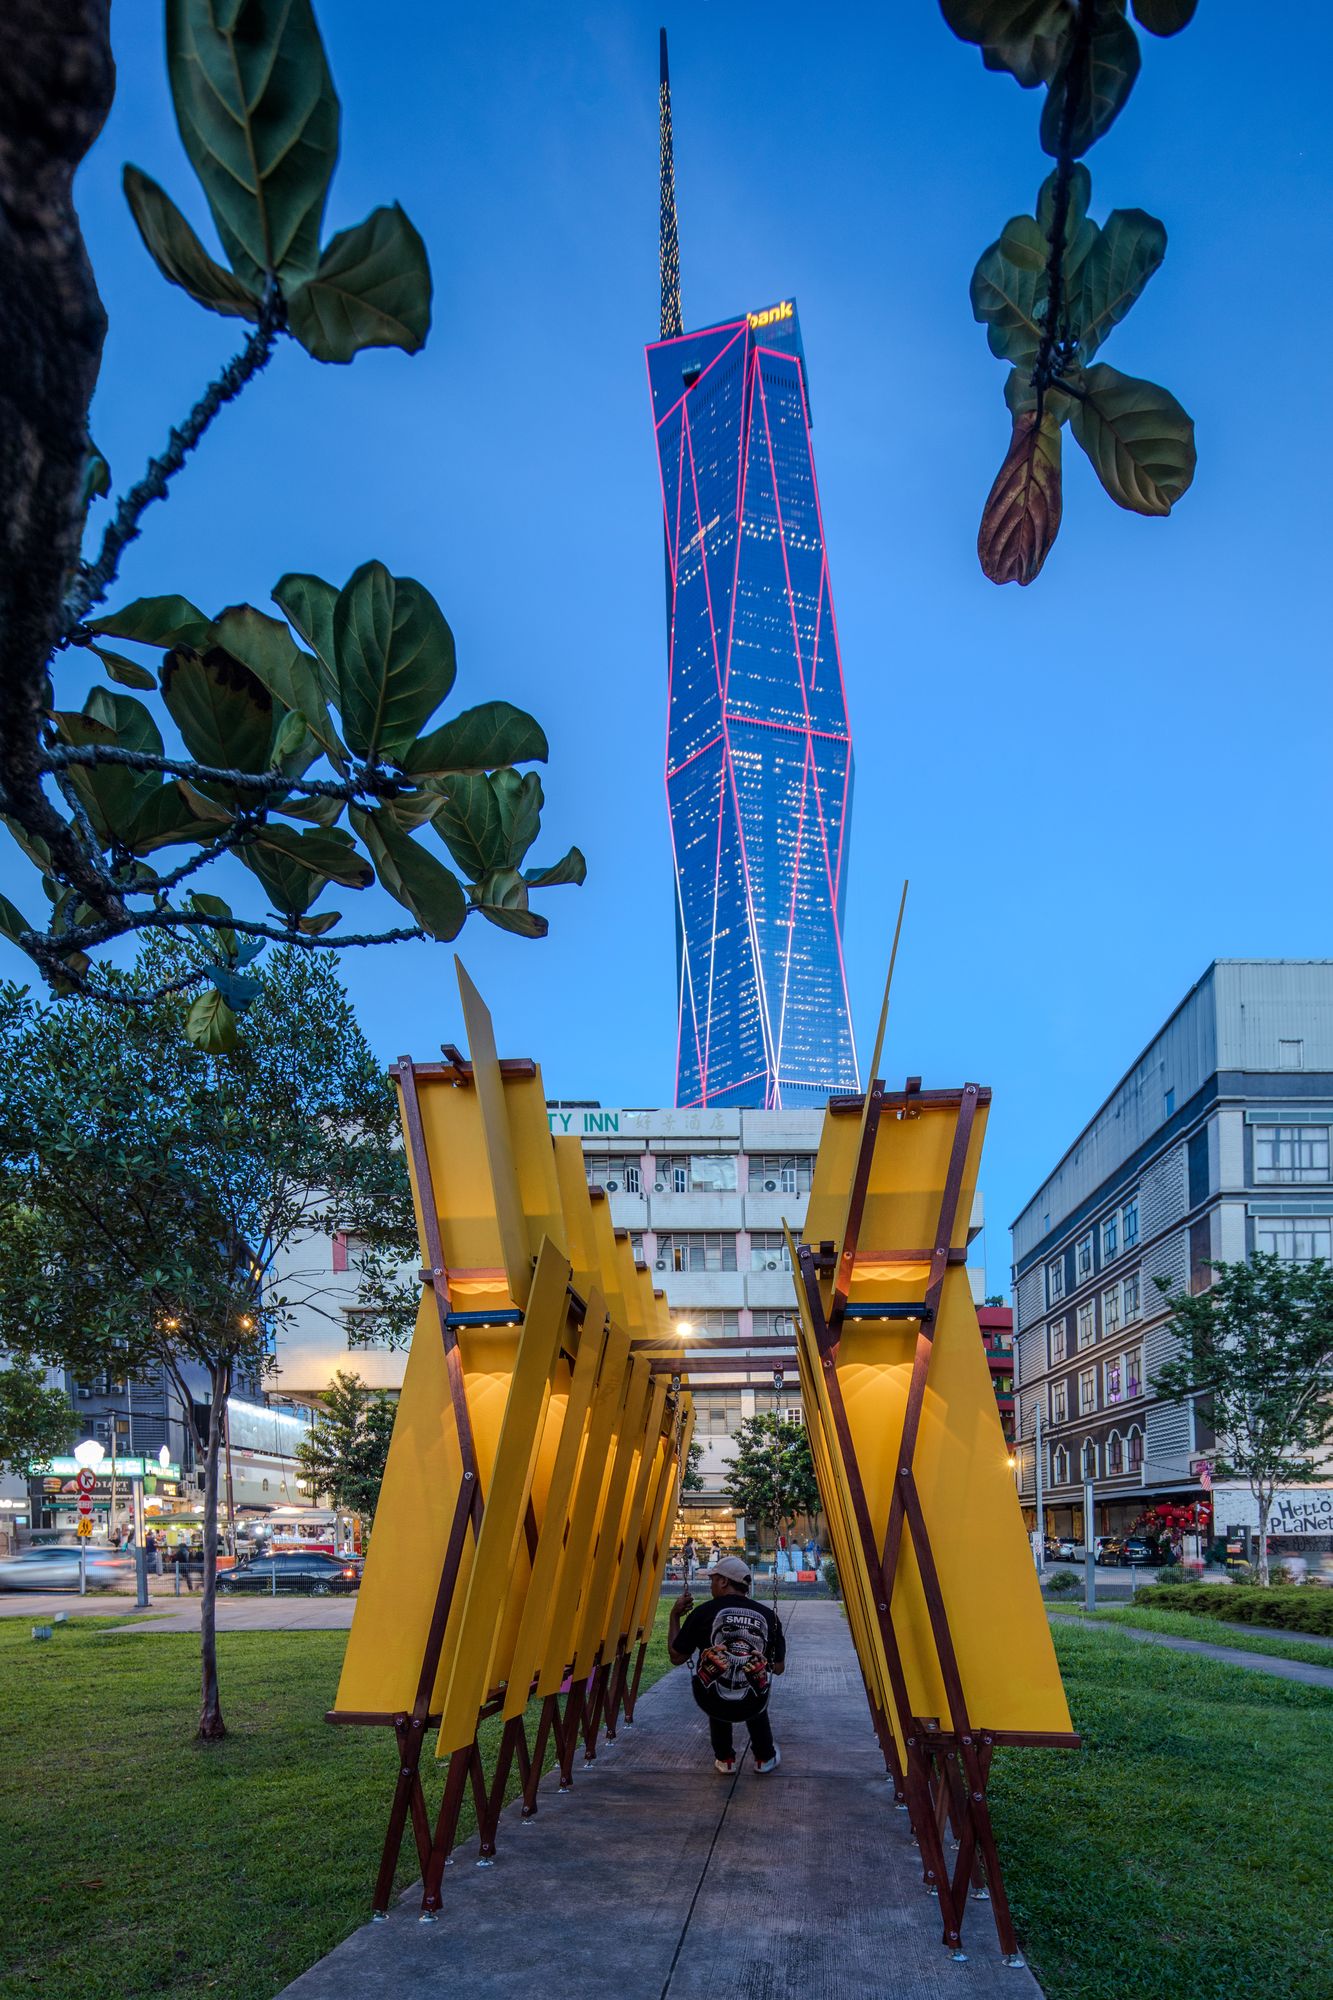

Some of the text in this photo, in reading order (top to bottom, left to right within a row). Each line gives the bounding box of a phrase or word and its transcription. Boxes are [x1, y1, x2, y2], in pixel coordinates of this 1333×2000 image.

[747, 302, 792, 330] bank
[547, 1113, 619, 1132] TY INN
[726, 1615, 761, 1628] SMILE
